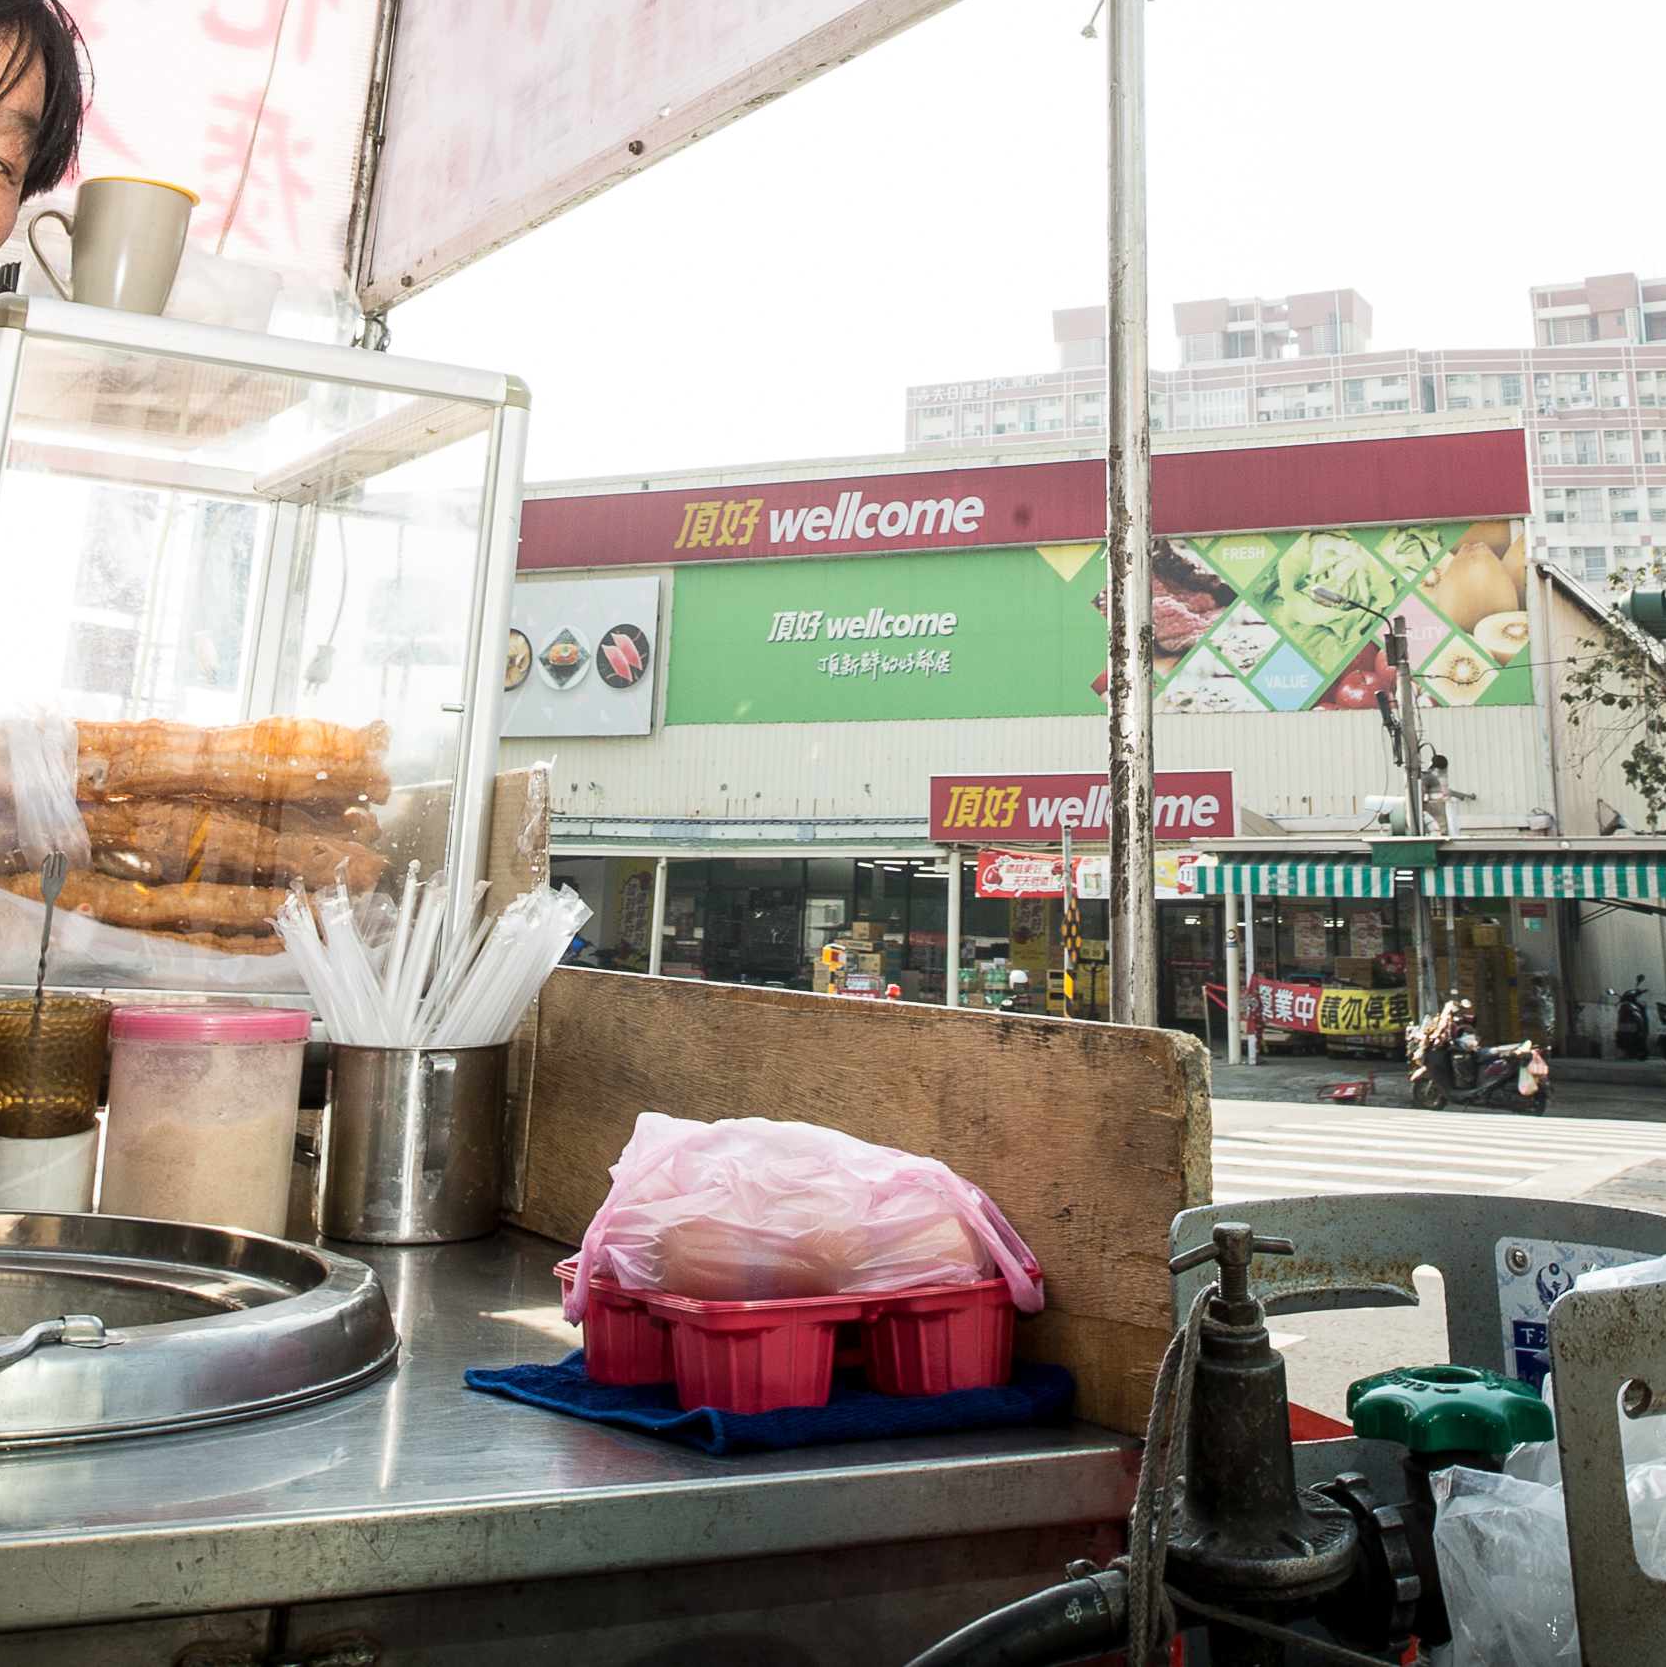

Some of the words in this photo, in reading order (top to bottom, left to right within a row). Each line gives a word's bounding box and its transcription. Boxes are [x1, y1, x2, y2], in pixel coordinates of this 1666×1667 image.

[674, 497, 765, 549] 頂好
[768, 490, 985, 545] wellcome
[1221, 545, 1266, 562] FRESH
[767, 610, 824, 643] 頂好
[827, 608, 958, 641] wellcome
[817, 648, 951, 681] 頂新鮮的好鄰居
[1264, 673, 1309, 691] VALUE
[943, 786, 1022, 827] 頂好
[1027, 785, 1220, 827] wellme
[1320, 993, 1413, 1030] 請勿停車
